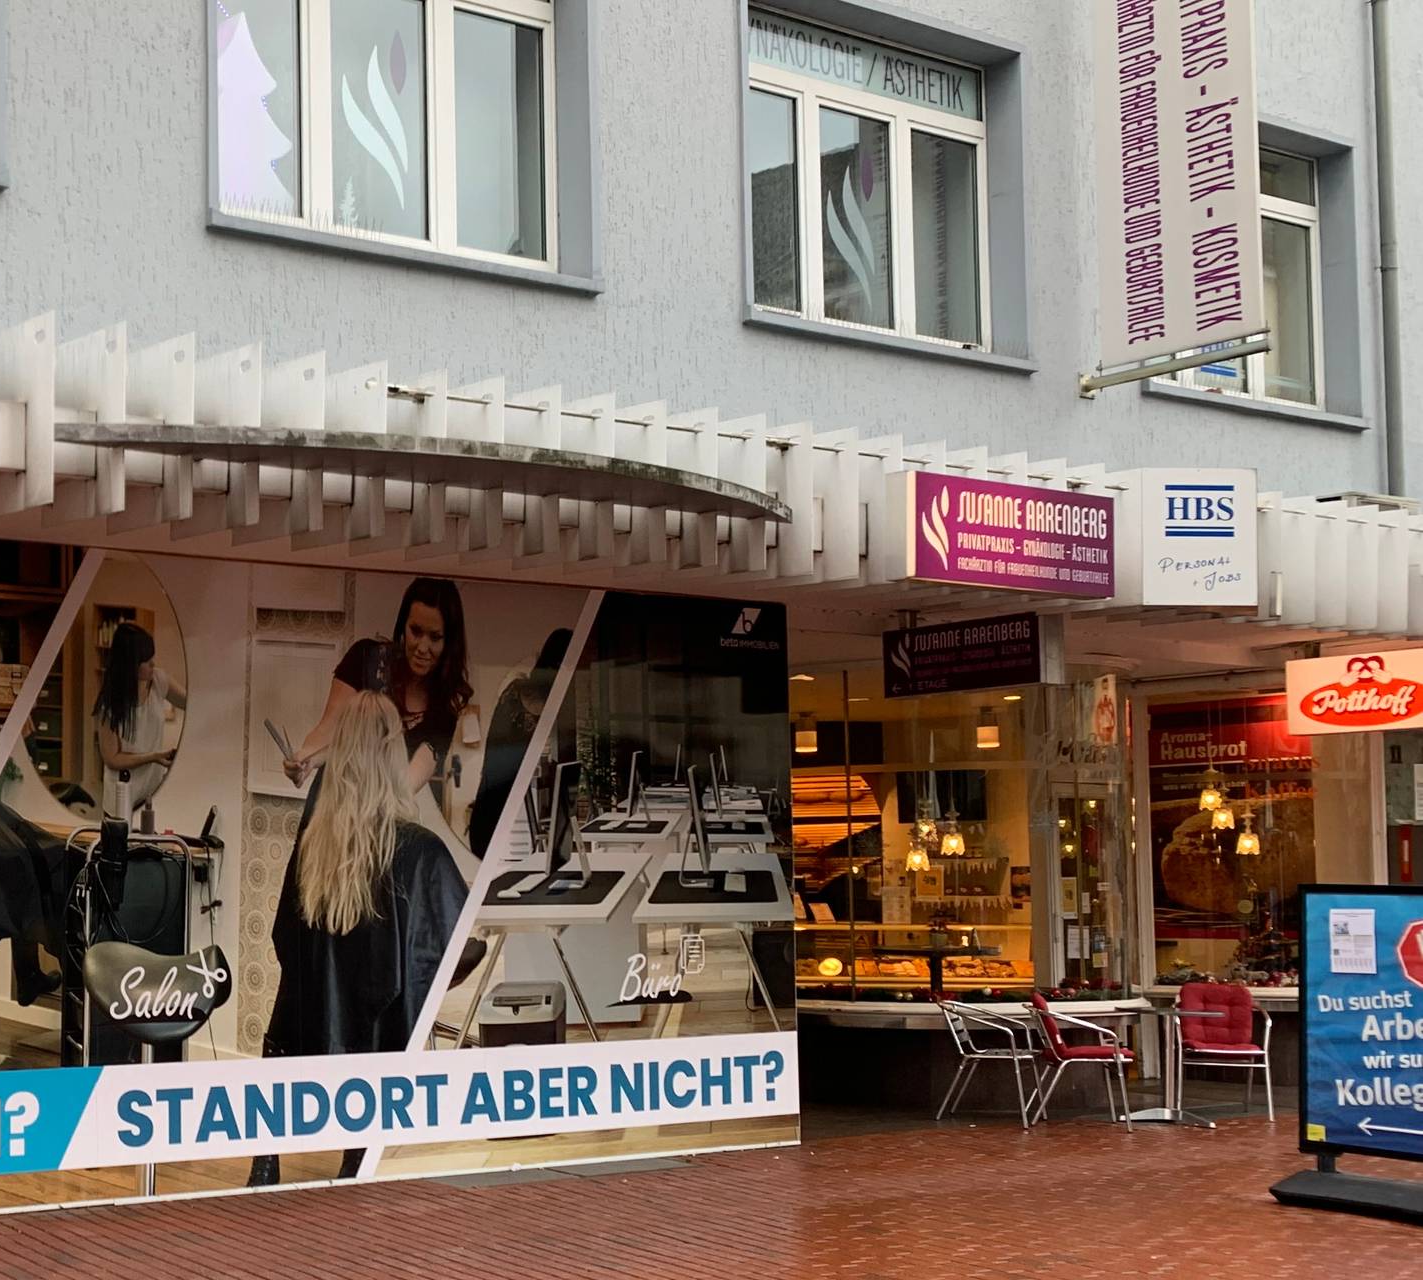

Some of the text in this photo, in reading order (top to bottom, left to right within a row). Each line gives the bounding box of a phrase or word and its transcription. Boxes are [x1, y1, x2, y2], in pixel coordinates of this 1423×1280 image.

[883, 55, 964, 112] ÄSTHETIK
[1119, 50, 1162, 85] FÜR
[1120, 80, 1160, 213] FRAUENHEILKUNDE
[1185, 96, 1239, 202] ÄSTHETIK
[1124, 209, 1162, 244] UND
[1125, 243, 1165, 345] GEBURTSHILFE
[1192, 223, 1243, 331] KOSMETIK
[957, 491, 1107, 540] SUSANNE ARRENBERG
[1165, 496, 1234, 521] HBS
[957, 532, 1015, 554] PRIVATPRAXIS
[1023, 538, 1065, 561] GYNÄKOLOGIE
[1072, 543, 1108, 565] ÄSTHETIK
[914, 620, 1031, 652] SUSANNE ARRENBERG
[1311, 684, 1417, 716] Potthoff
[1160, 740, 1248, 761] Hausbrot
[109, 966, 198, 1020] Salon
[620, 953, 682, 1002] Büro
[1317, 990, 1414, 1013] Du suchst
[1362, 1050, 1423, 1069] wir su
[117, 1073, 450, 1148] STANDORT
[461, 1065, 599, 1123] ABER
[611, 1049, 785, 1113] NICHT?
